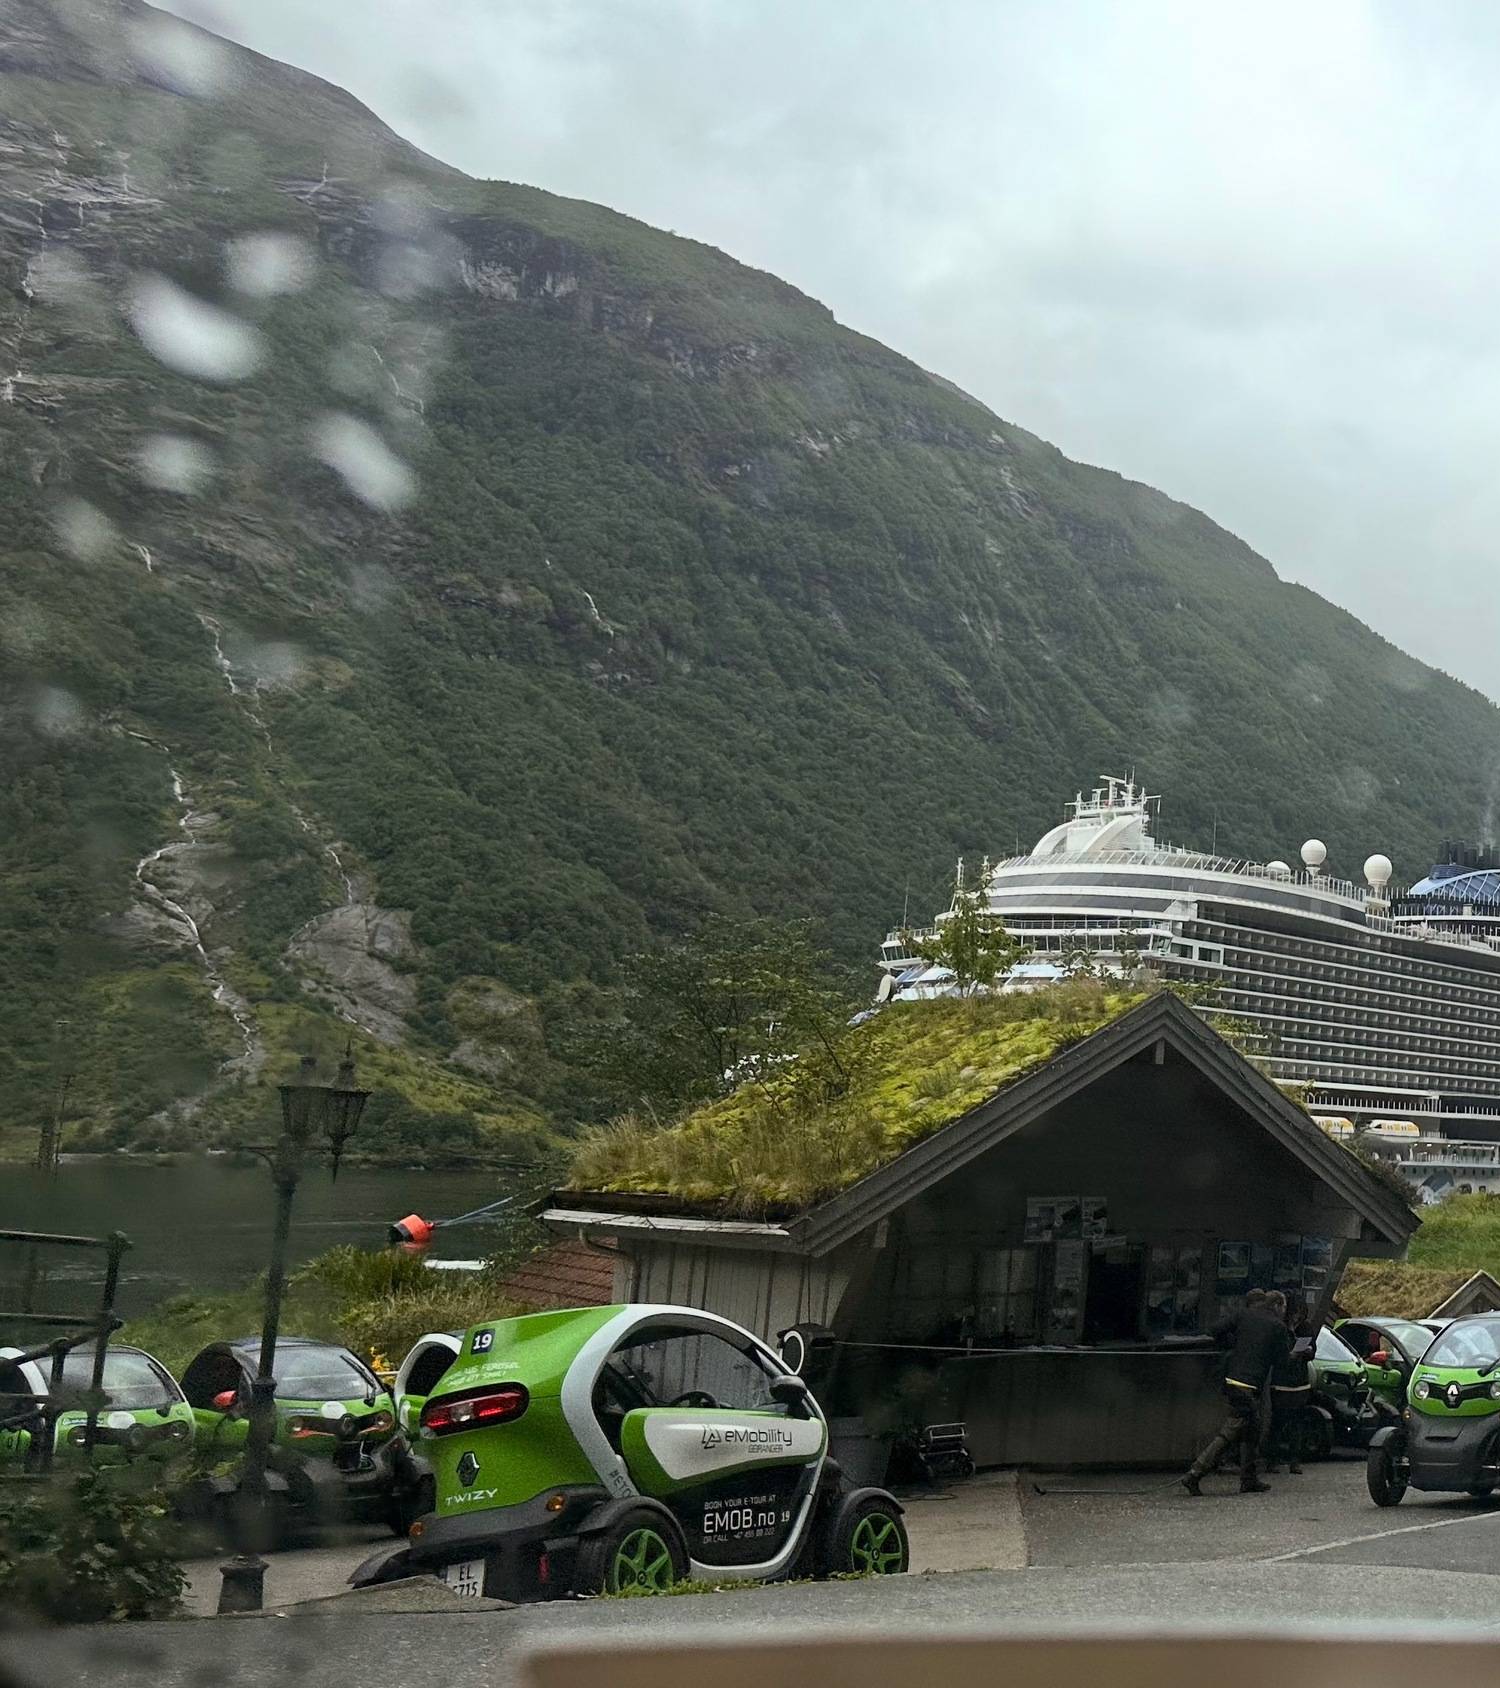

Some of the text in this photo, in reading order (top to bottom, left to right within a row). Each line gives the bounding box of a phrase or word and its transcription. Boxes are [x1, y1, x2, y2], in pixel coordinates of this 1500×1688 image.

[473, 1333, 492, 1350] 19
[725, 1429, 792, 1446] eMobility
[445, 1488, 498, 1506] TWIZY
[724, 1498, 742, 1507] YOUR
[704, 1508, 776, 1533] EMOB.no
[781, 1510, 791, 1522] 19
[460, 1564, 475, 1581] EL
